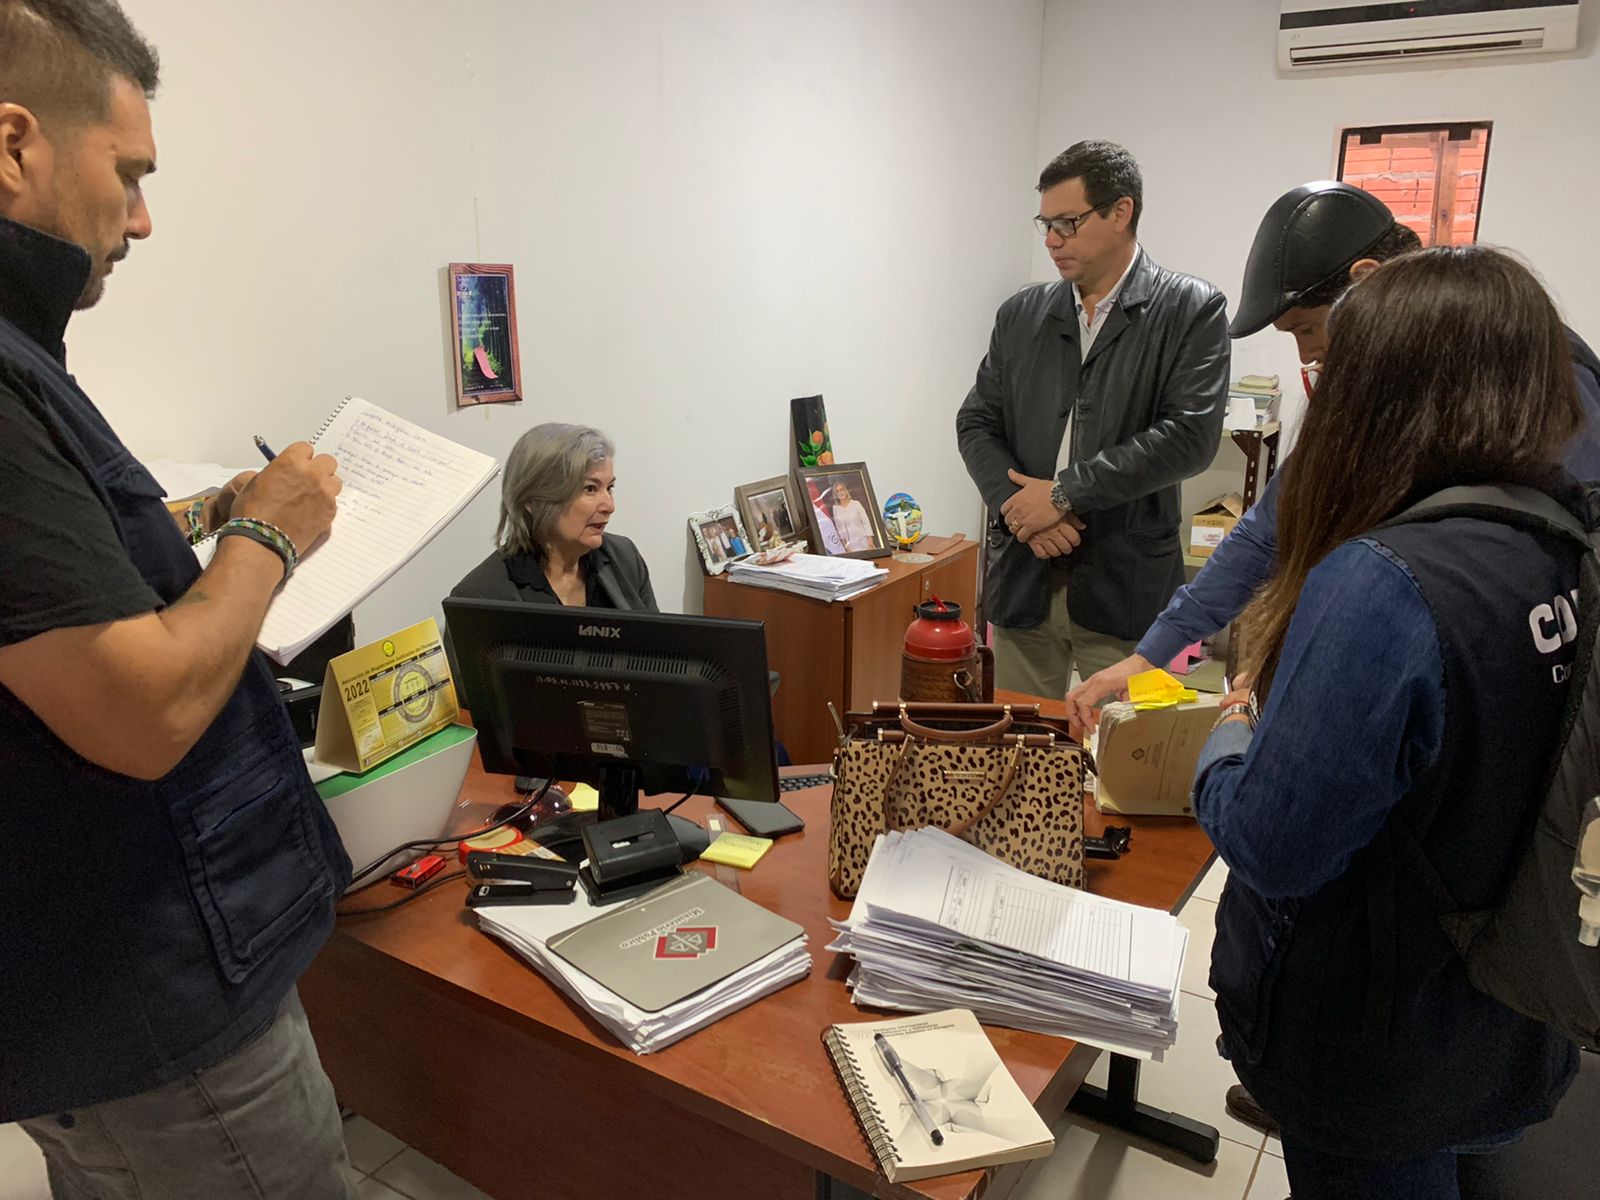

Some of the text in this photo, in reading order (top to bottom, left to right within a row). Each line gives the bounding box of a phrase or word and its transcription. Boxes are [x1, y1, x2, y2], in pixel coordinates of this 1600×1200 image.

[579, 624, 621, 638] LANIX
[1529, 589, 1578, 654] CO
[344, 679, 370, 702] 2022
